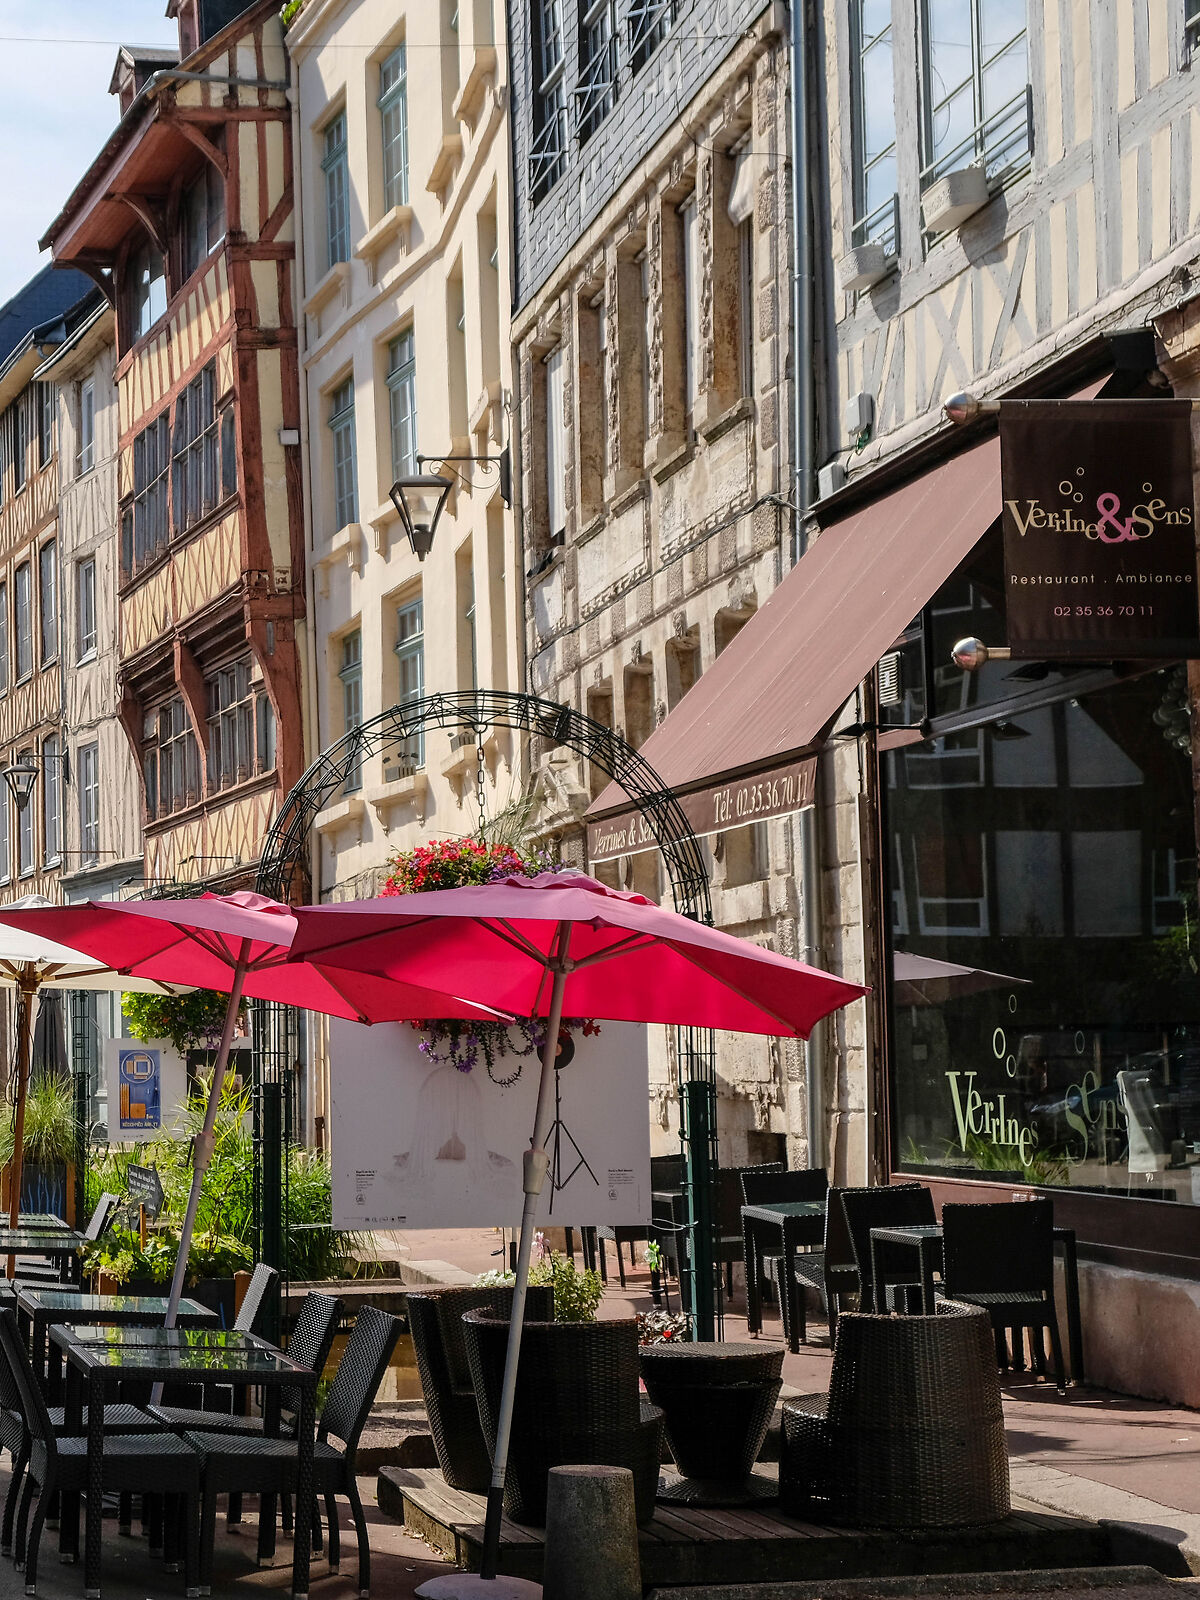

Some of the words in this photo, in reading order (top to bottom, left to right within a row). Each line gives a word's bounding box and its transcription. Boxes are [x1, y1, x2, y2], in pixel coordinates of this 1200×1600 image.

[1096, 492, 1140, 543] &
[1131, 499, 1191, 538] Sens
[1011, 574, 1095, 585] Restaurant
[1115, 573, 1192, 584] Ambiance
[1053, 606, 1071, 617] 02
[1075, 606, 1093, 617] 35
[1096, 606, 1114, 617] 36
[1118, 606, 1135, 617] 70
[1140, 605, 1153, 616] 11
[593, 826, 627, 855] Verrines
[628, 818, 637, 847] &
[736, 771, 808, 817] 02.35.36.70.11
